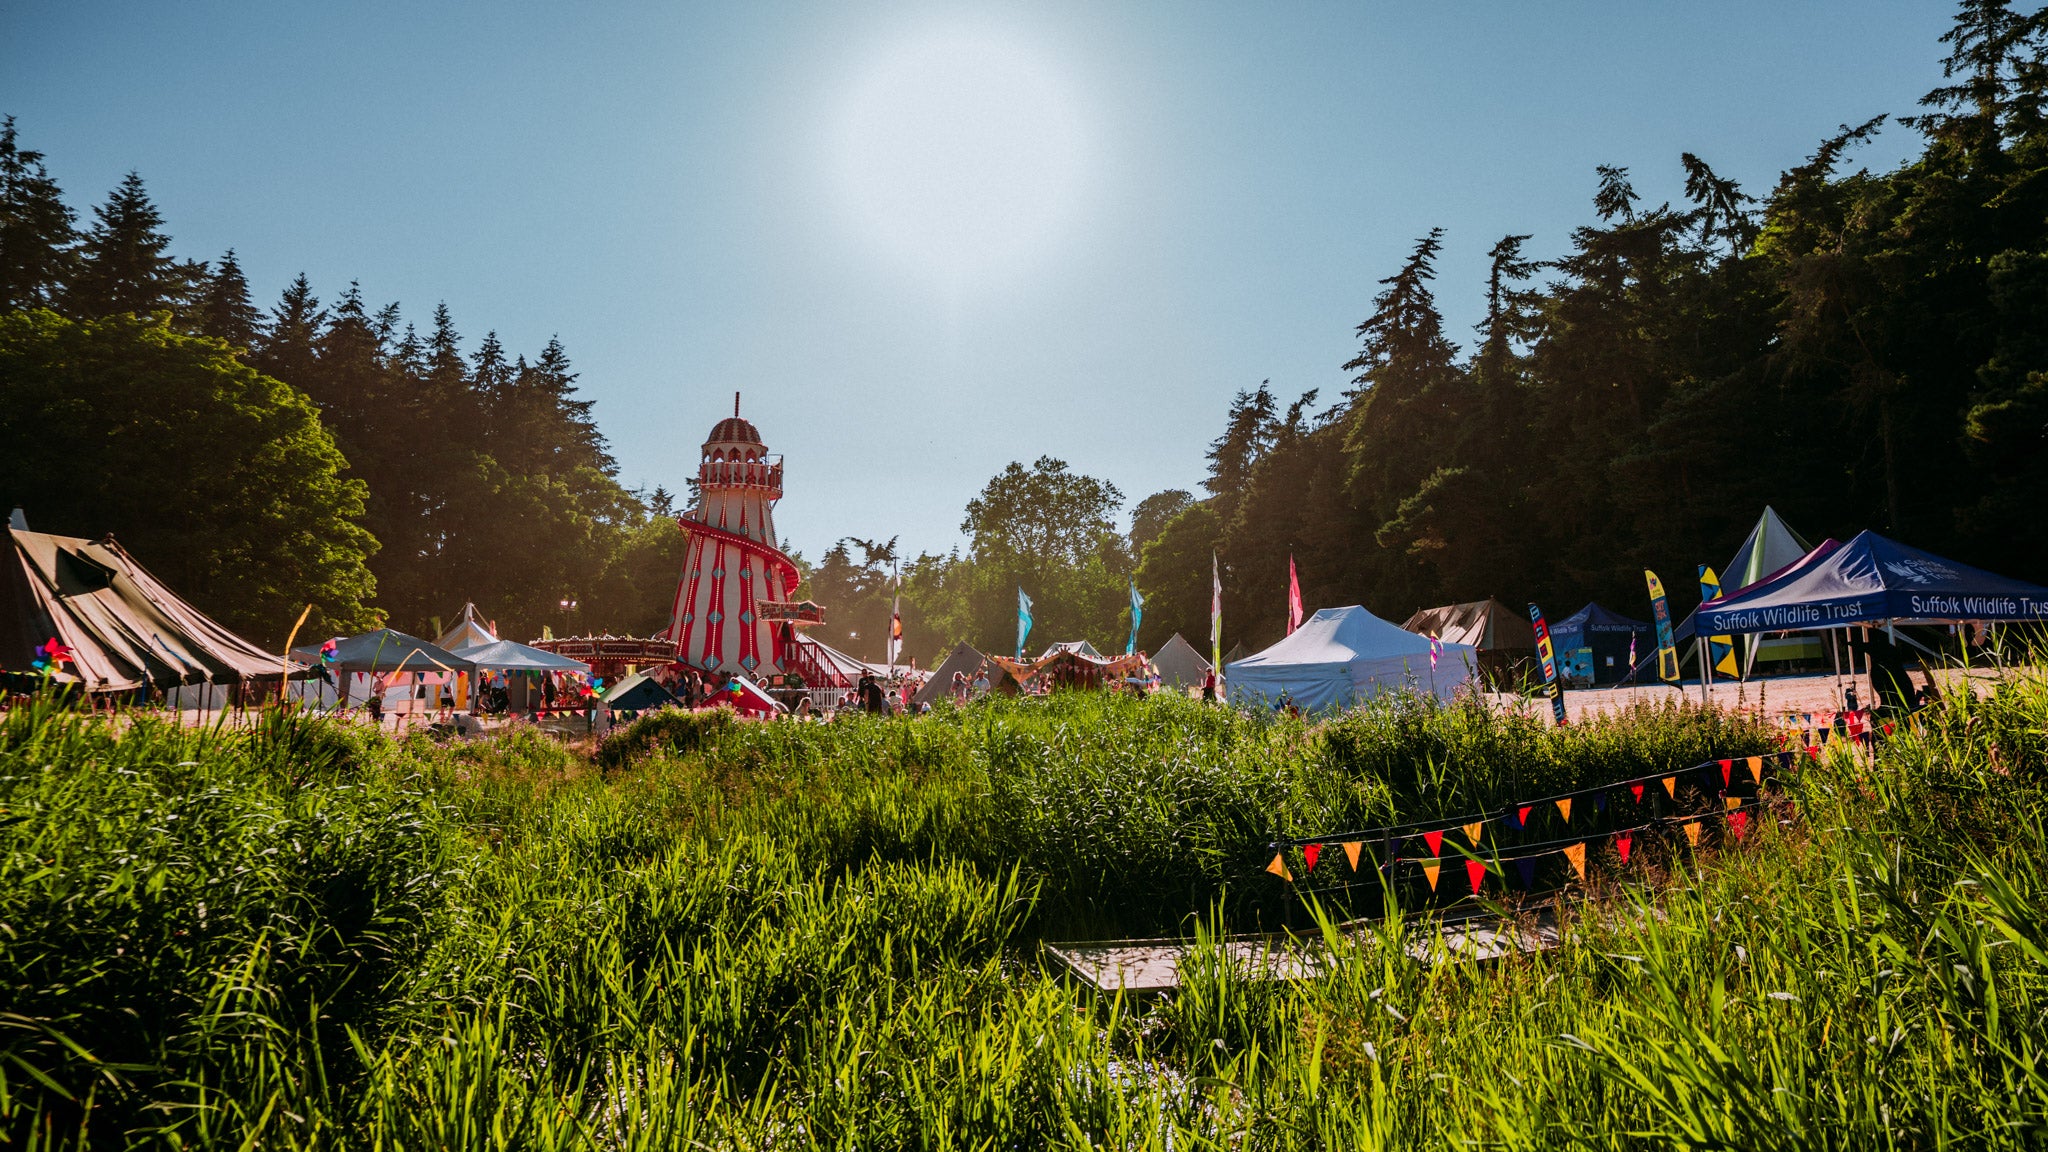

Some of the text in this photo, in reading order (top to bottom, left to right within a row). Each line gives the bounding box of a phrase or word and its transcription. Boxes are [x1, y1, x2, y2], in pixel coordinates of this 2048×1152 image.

[1713, 600, 1863, 631] Suffolk Wildlife Trust
[1911, 595, 1960, 614] Suffolk
[1963, 596, 2017, 615] Wildlife
